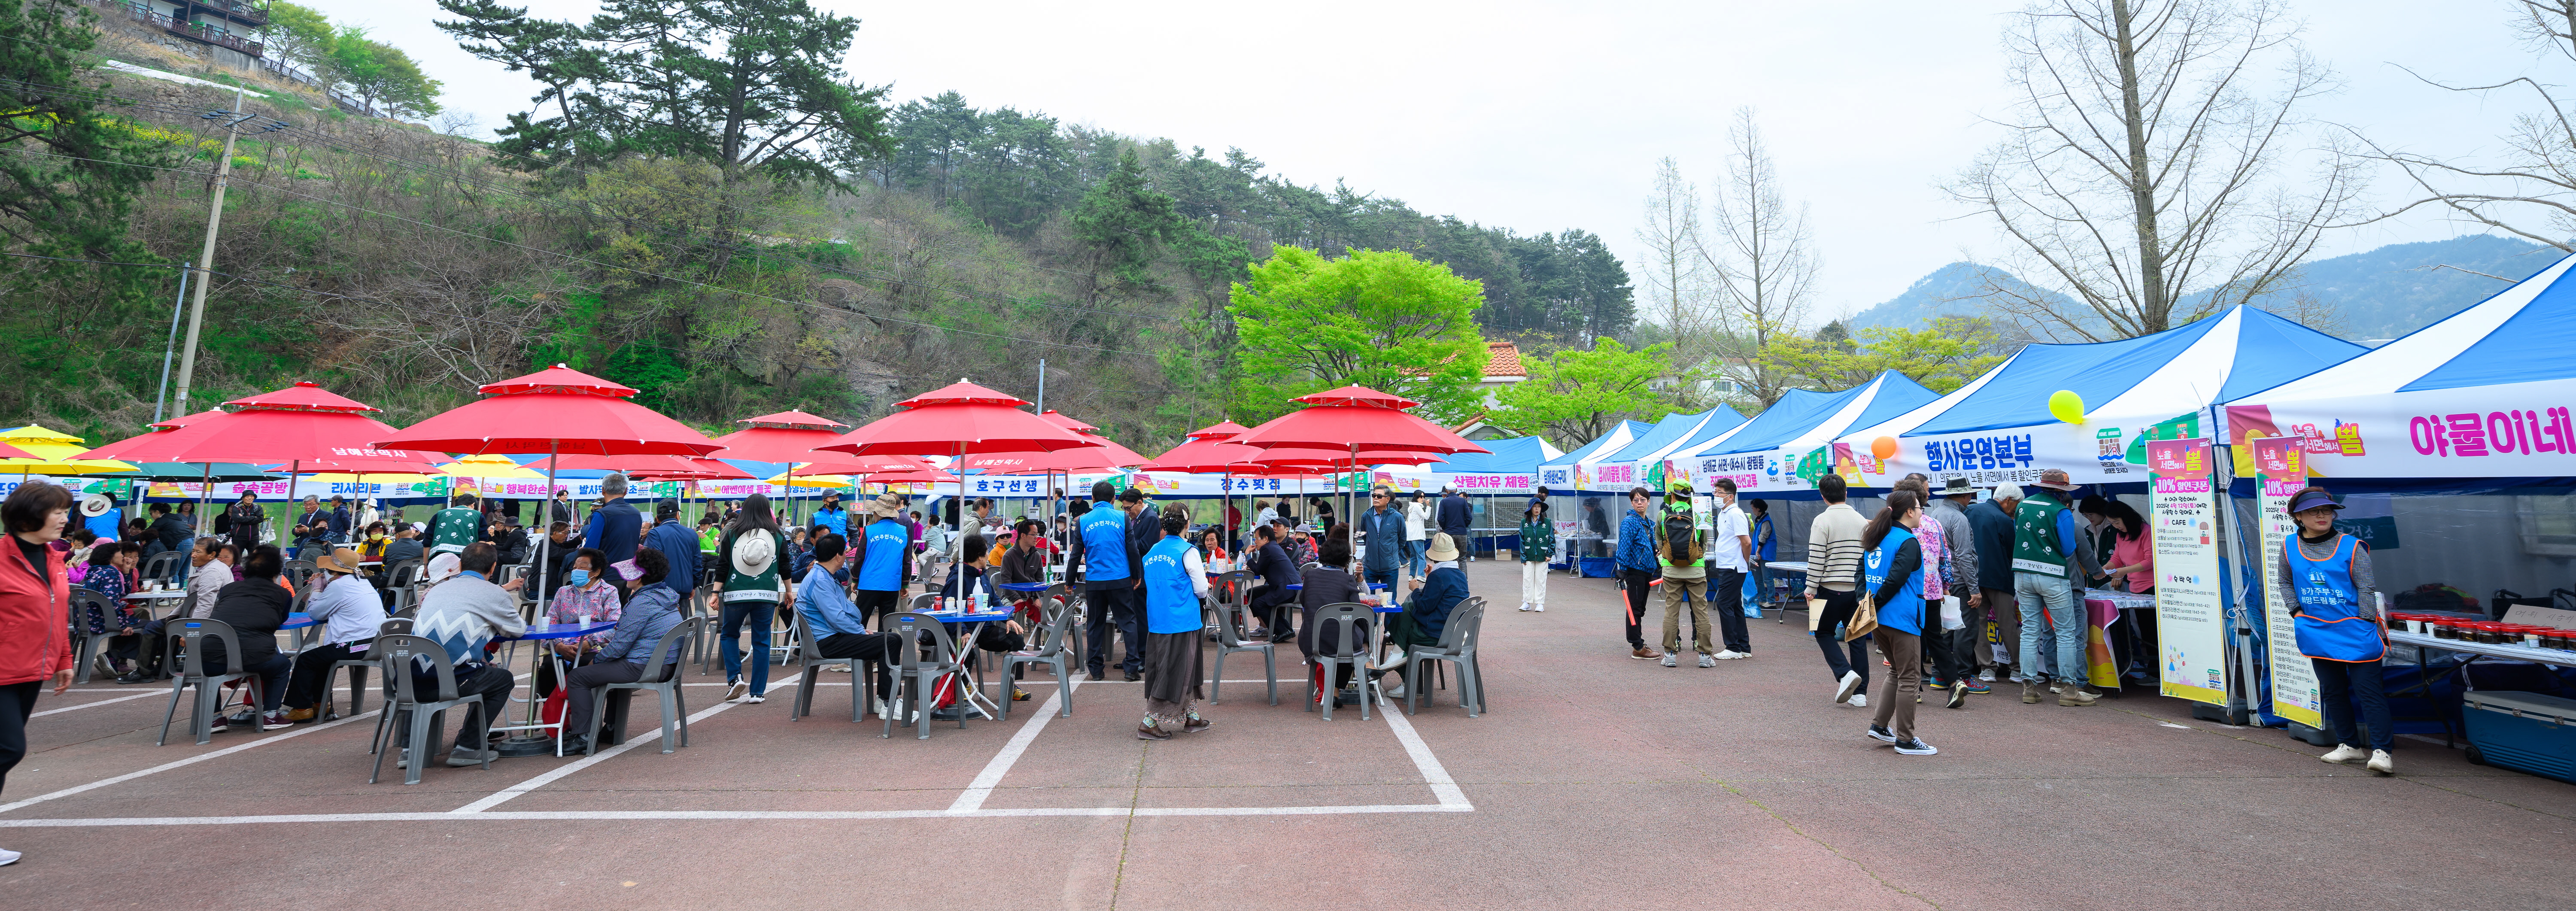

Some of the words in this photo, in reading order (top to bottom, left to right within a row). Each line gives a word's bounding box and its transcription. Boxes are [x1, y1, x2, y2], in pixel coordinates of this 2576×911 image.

[2293, 426, 2316, 437] 노을
[2410, 406, 2576, 458] 야물이네
[2306, 439, 2339, 451] 서면에서
[2336, 426, 2363, 454] 봄
[331, 448, 407, 458] 남해천막사
[1925, 434, 2034, 471] 행사운영본부
[2157, 450, 2171, 460] 노을
[2263, 449, 2276, 460] 노을
[1703, 459, 1716, 473] 남해군
[1718, 456, 1746, 472] 서면·여수시
[1747, 455, 1764, 471] 광림동
[1875, 457, 1884, 474] 봄
[2160, 460, 2184, 470] 서면에서
[2185, 450, 2202, 471] 봄
[2268, 460, 2287, 471] 서면에서
[2287, 449, 2300, 472] 봄
[1544, 470, 1567, 484] 남해생선구이
[1598, 465, 1620, 483] 업사이클링
[1621, 465, 1631, 483] 체험
[1971, 471, 1982, 483] 노을
[1985, 471, 2009, 483] 서면에서
[2011, 470, 2017, 482] 봄
[232, 481, 288, 494] 숲속공방
[977, 480, 1037, 492] 호구선생
[1221, 478, 1280, 491] 장수횟집
[1453, 476, 1501, 488] 산림치유
[1504, 476, 1528, 488] 체험
[1735, 474, 1758, 488] 친선교류
[2157, 479, 2175, 492] 10%
[2177, 481, 2208, 491] 할인쿠폰
[2266, 480, 2282, 494] 10%
[331, 482, 381, 494] 리사리본
[721, 485, 752, 494] 에벤에셀
[756, 485, 772, 494] 들꽃
[1085, 520, 1121, 533] 서면주민자치회
[870, 534, 904, 544] 서면주민자치회
[1144, 554, 1176, 567] 서면주민자치회
